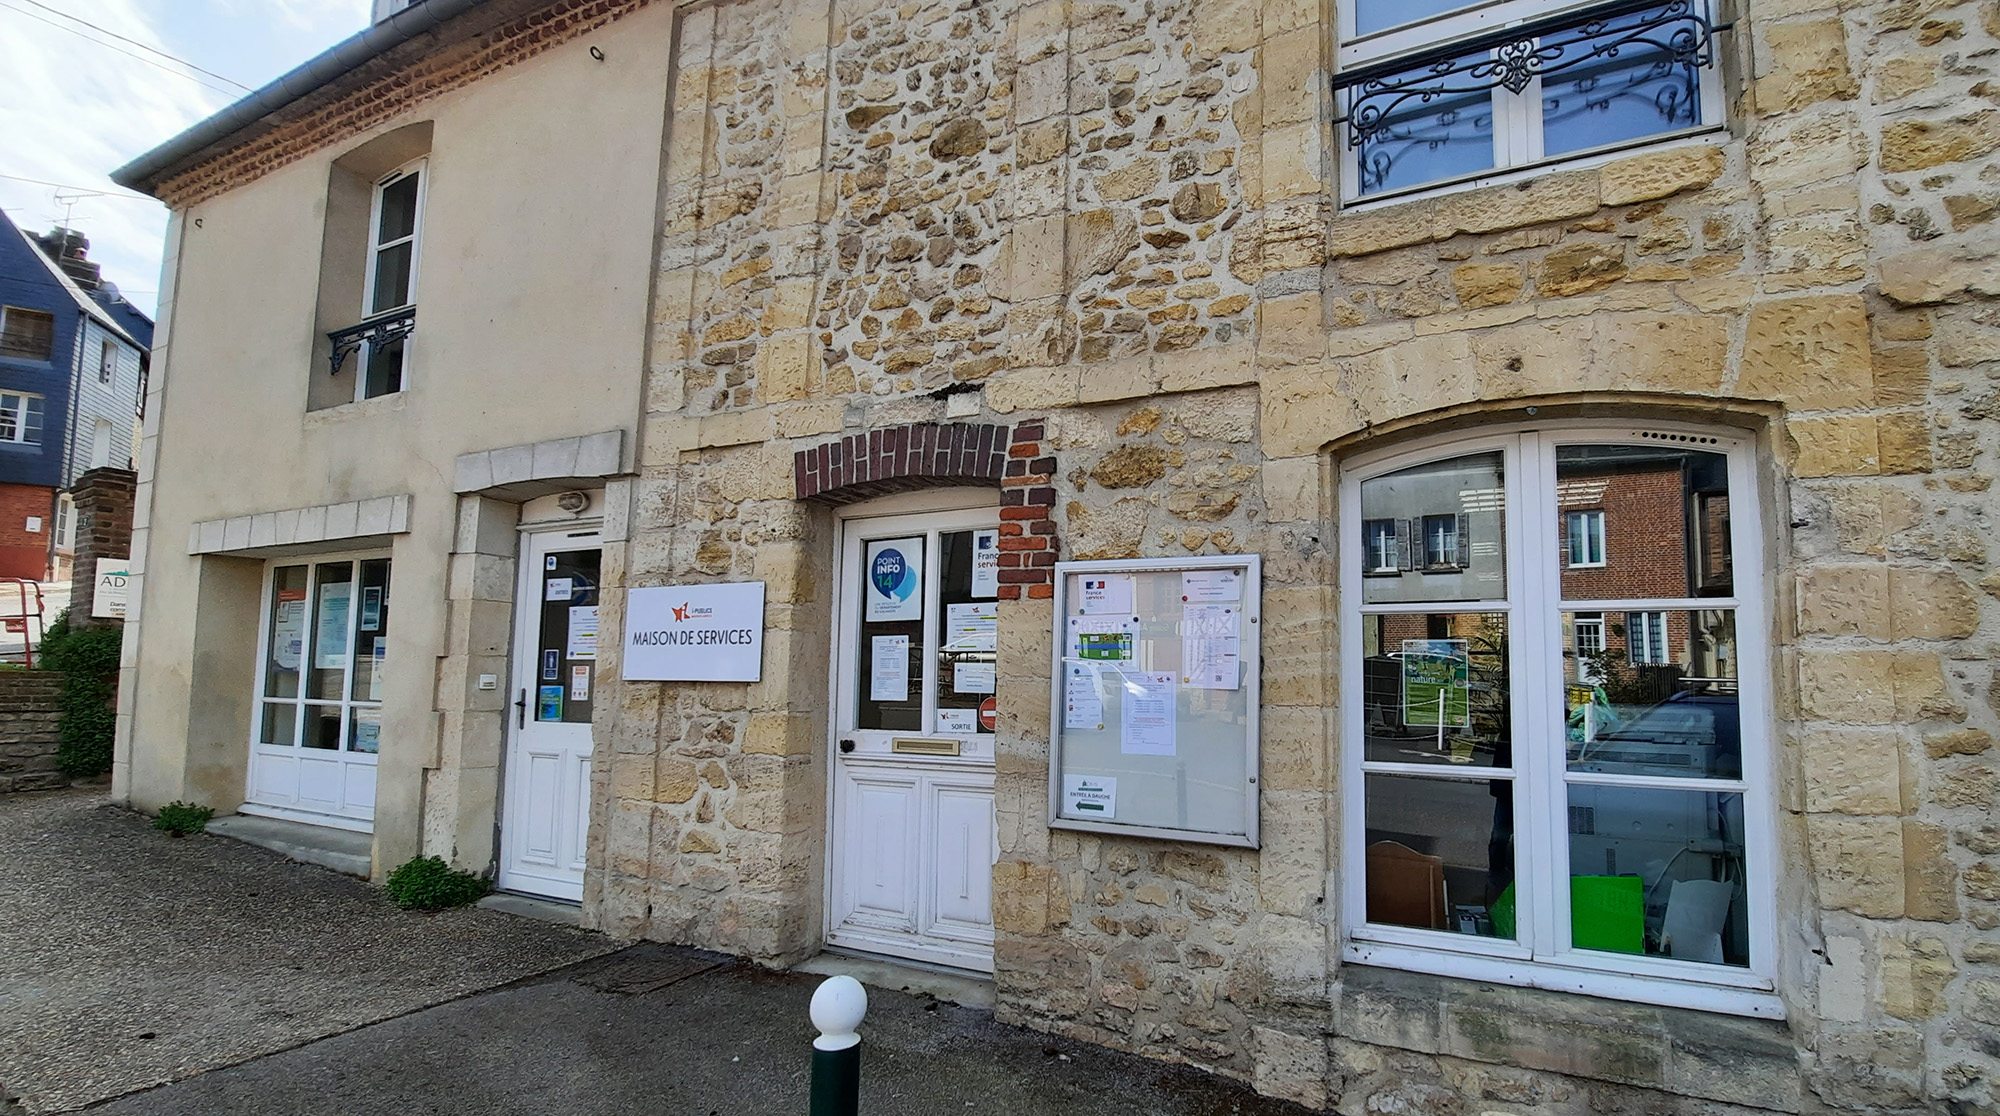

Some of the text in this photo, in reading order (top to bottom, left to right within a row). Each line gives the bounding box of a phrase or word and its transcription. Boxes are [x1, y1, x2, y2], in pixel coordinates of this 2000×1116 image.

[877, 556, 901, 565] POINT
[876, 564, 900, 574] INFO
[877, 575, 893, 588] 14
[632, 629, 753, 646] MAISON DE SERVICES
